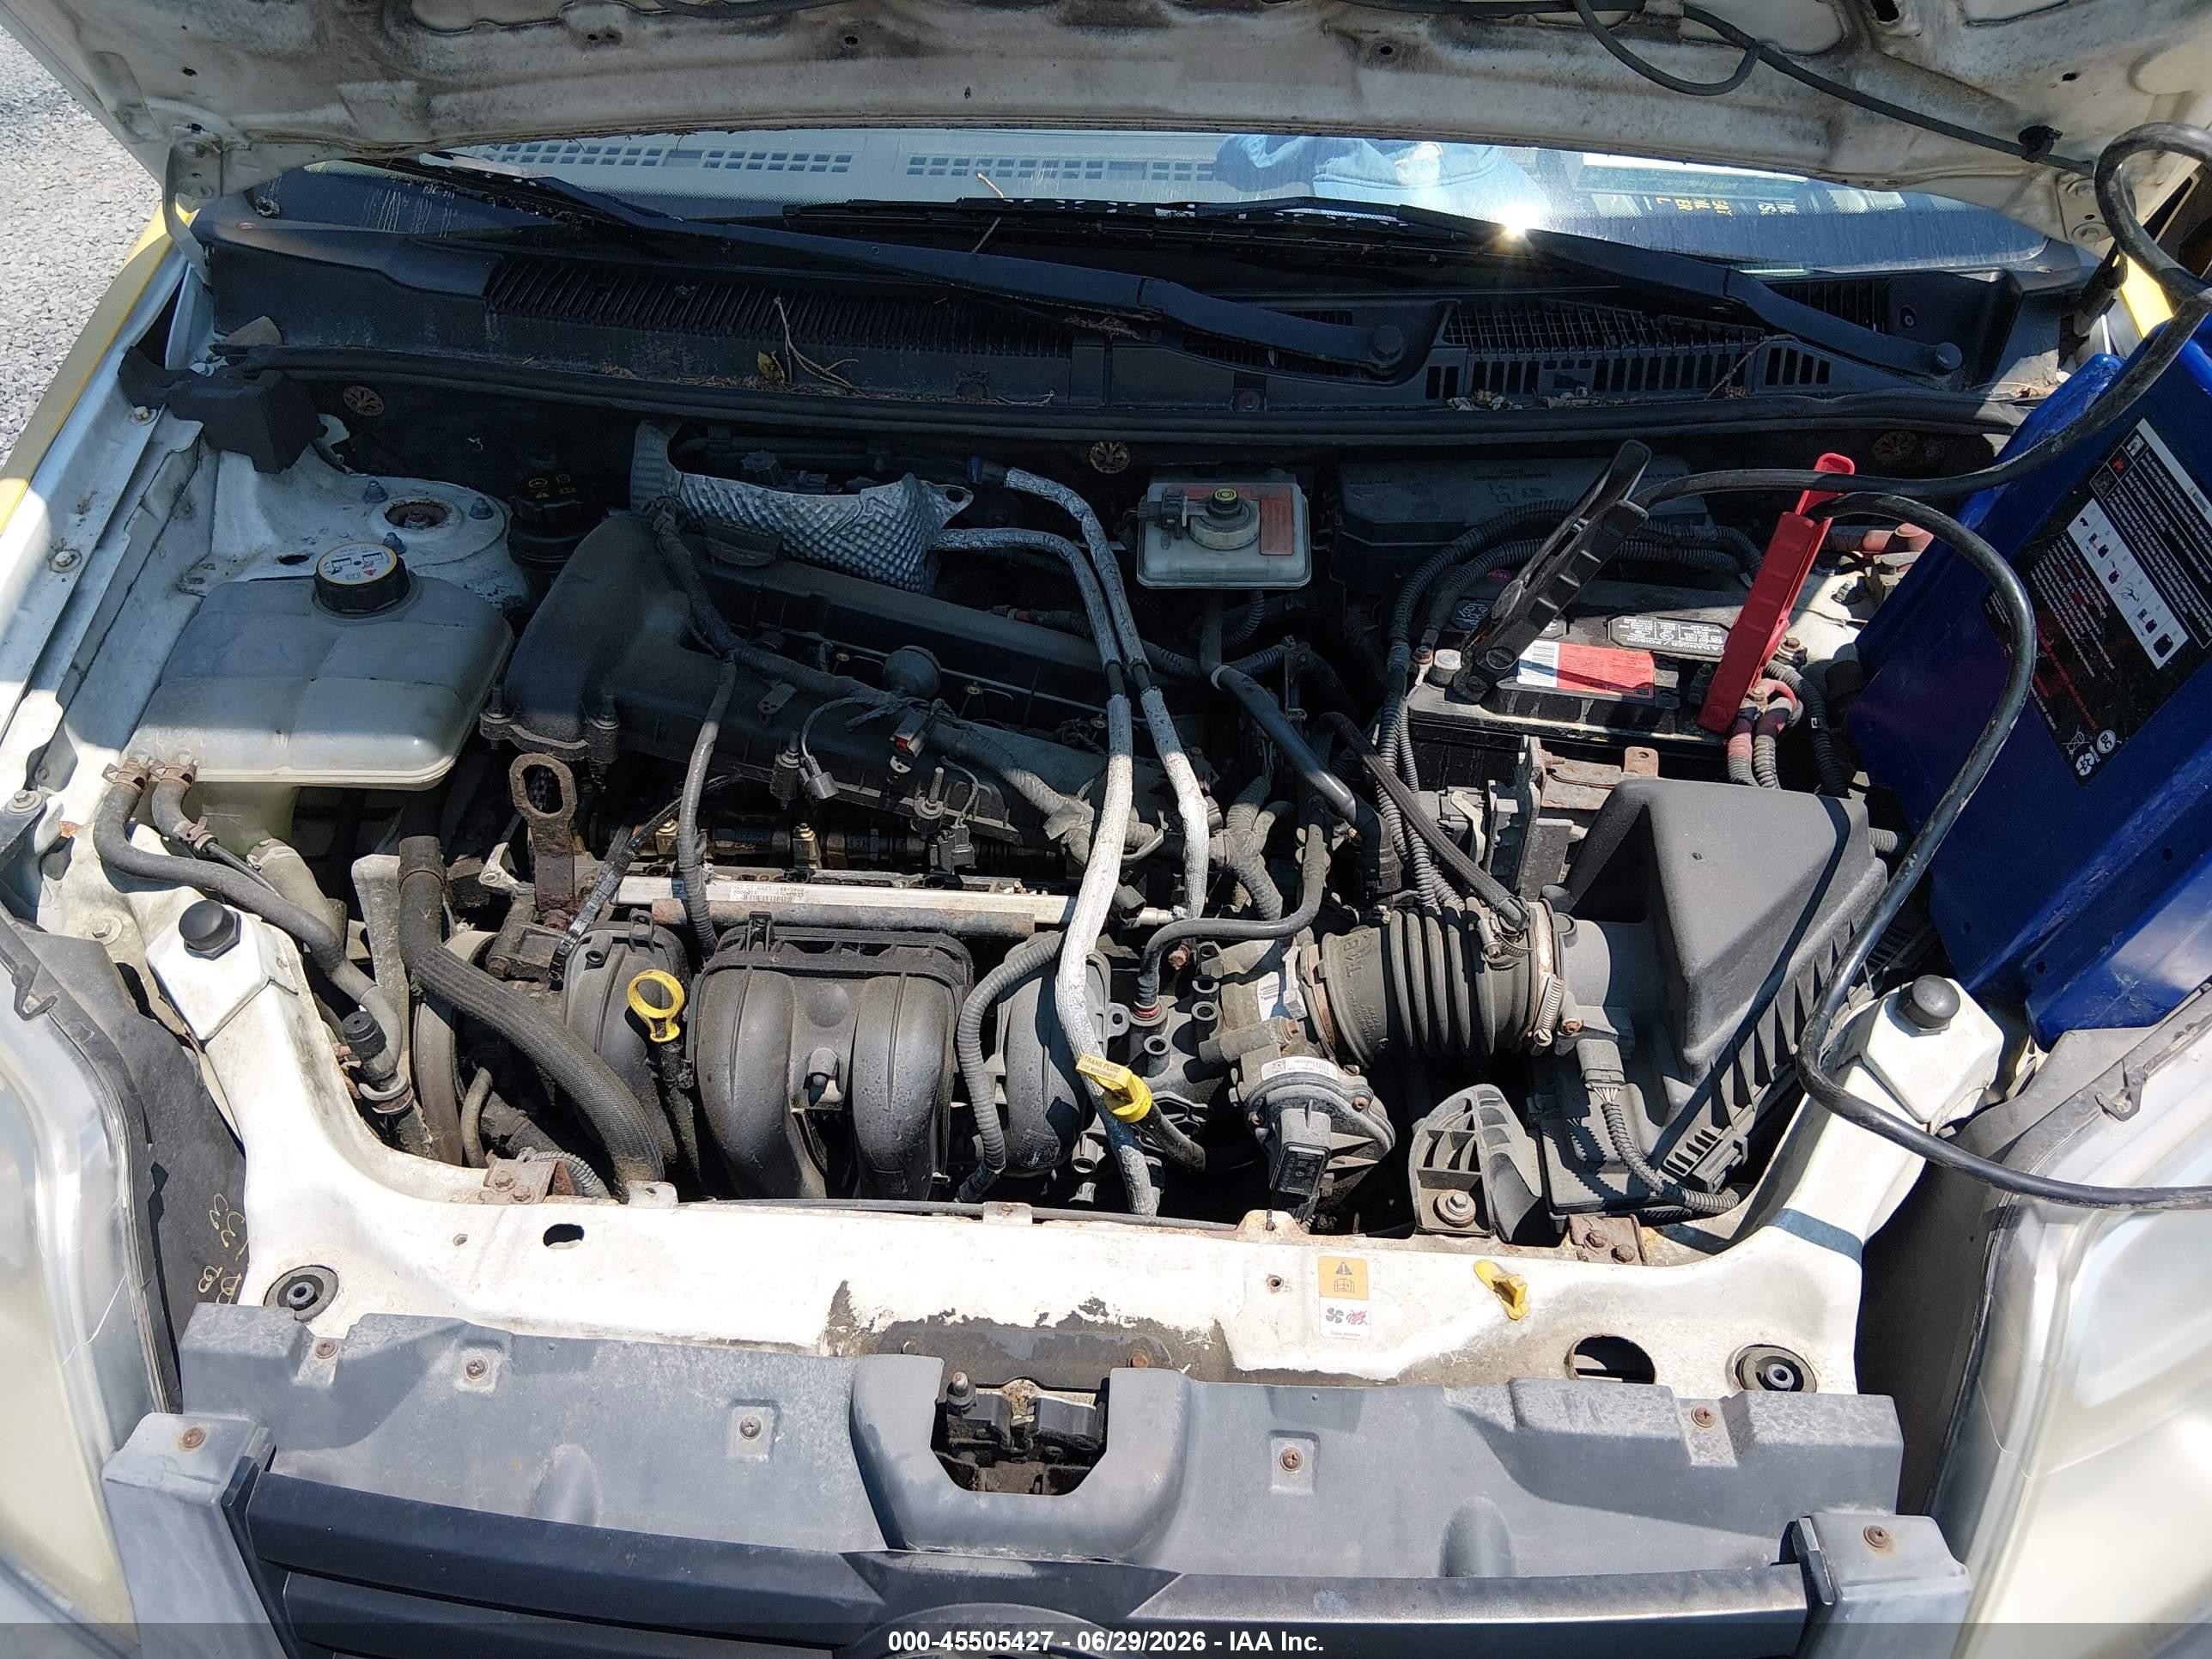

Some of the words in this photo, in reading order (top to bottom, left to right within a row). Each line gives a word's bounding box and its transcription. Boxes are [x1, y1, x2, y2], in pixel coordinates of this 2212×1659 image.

[1626, 636, 1662, 647] POISON
[1668, 641, 1712, 651] DANGER
[2100, 733, 2113, 750] BC
[1084, 1055, 1103, 1067] TRANS
